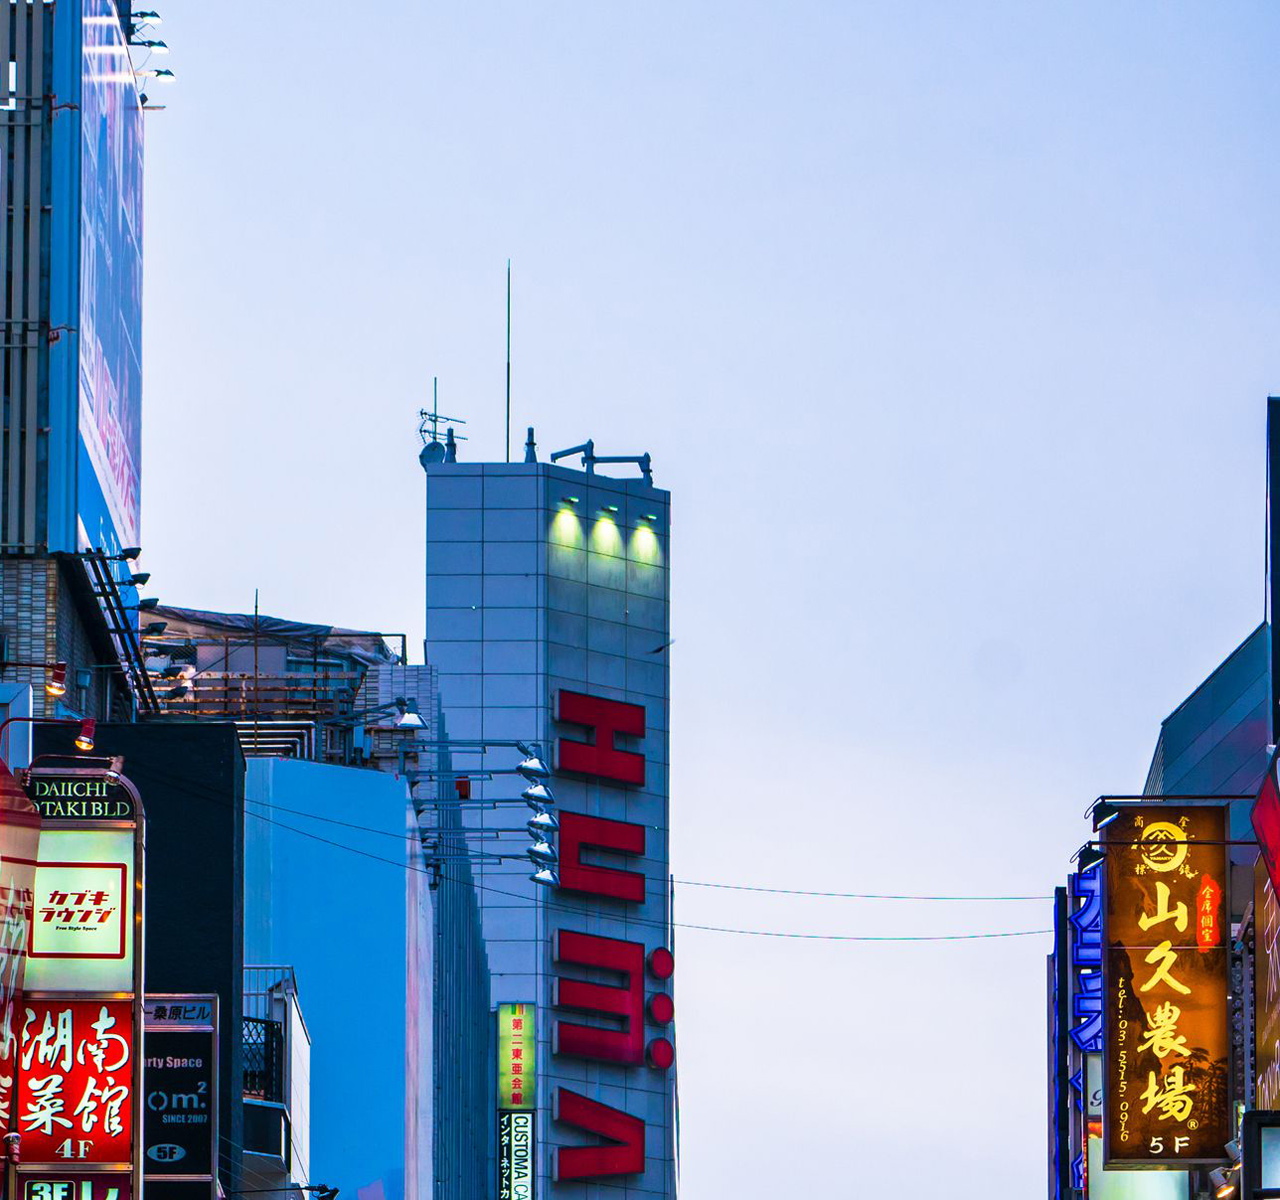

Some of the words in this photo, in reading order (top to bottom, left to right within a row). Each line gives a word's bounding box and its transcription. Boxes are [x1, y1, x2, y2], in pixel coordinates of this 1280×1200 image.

[35, 780, 109, 798] DAIICHI
[91, 802, 129, 817] BLD
[49, 890, 110, 905] カブキ
[38, 906, 117, 925] ラウンジ
[1136, 881, 1196, 1124] 山久農場
[20, 1006, 130, 1074] 湖南
[166, 1057, 202, 1070] Space
[510, 1017, 524, 1106] 第二東亜会館
[21, 1075, 129, 1136] 菜館
[163, 1114, 185, 1124] SINCE
[188, 1114, 207, 1124] 2007
[54, 1139, 94, 1160] 4F
[155, 1145, 178, 1161] 5F
[513, 1115, 529, 1181] CUSTOMA
[1149, 1135, 1191, 1154] 5F
